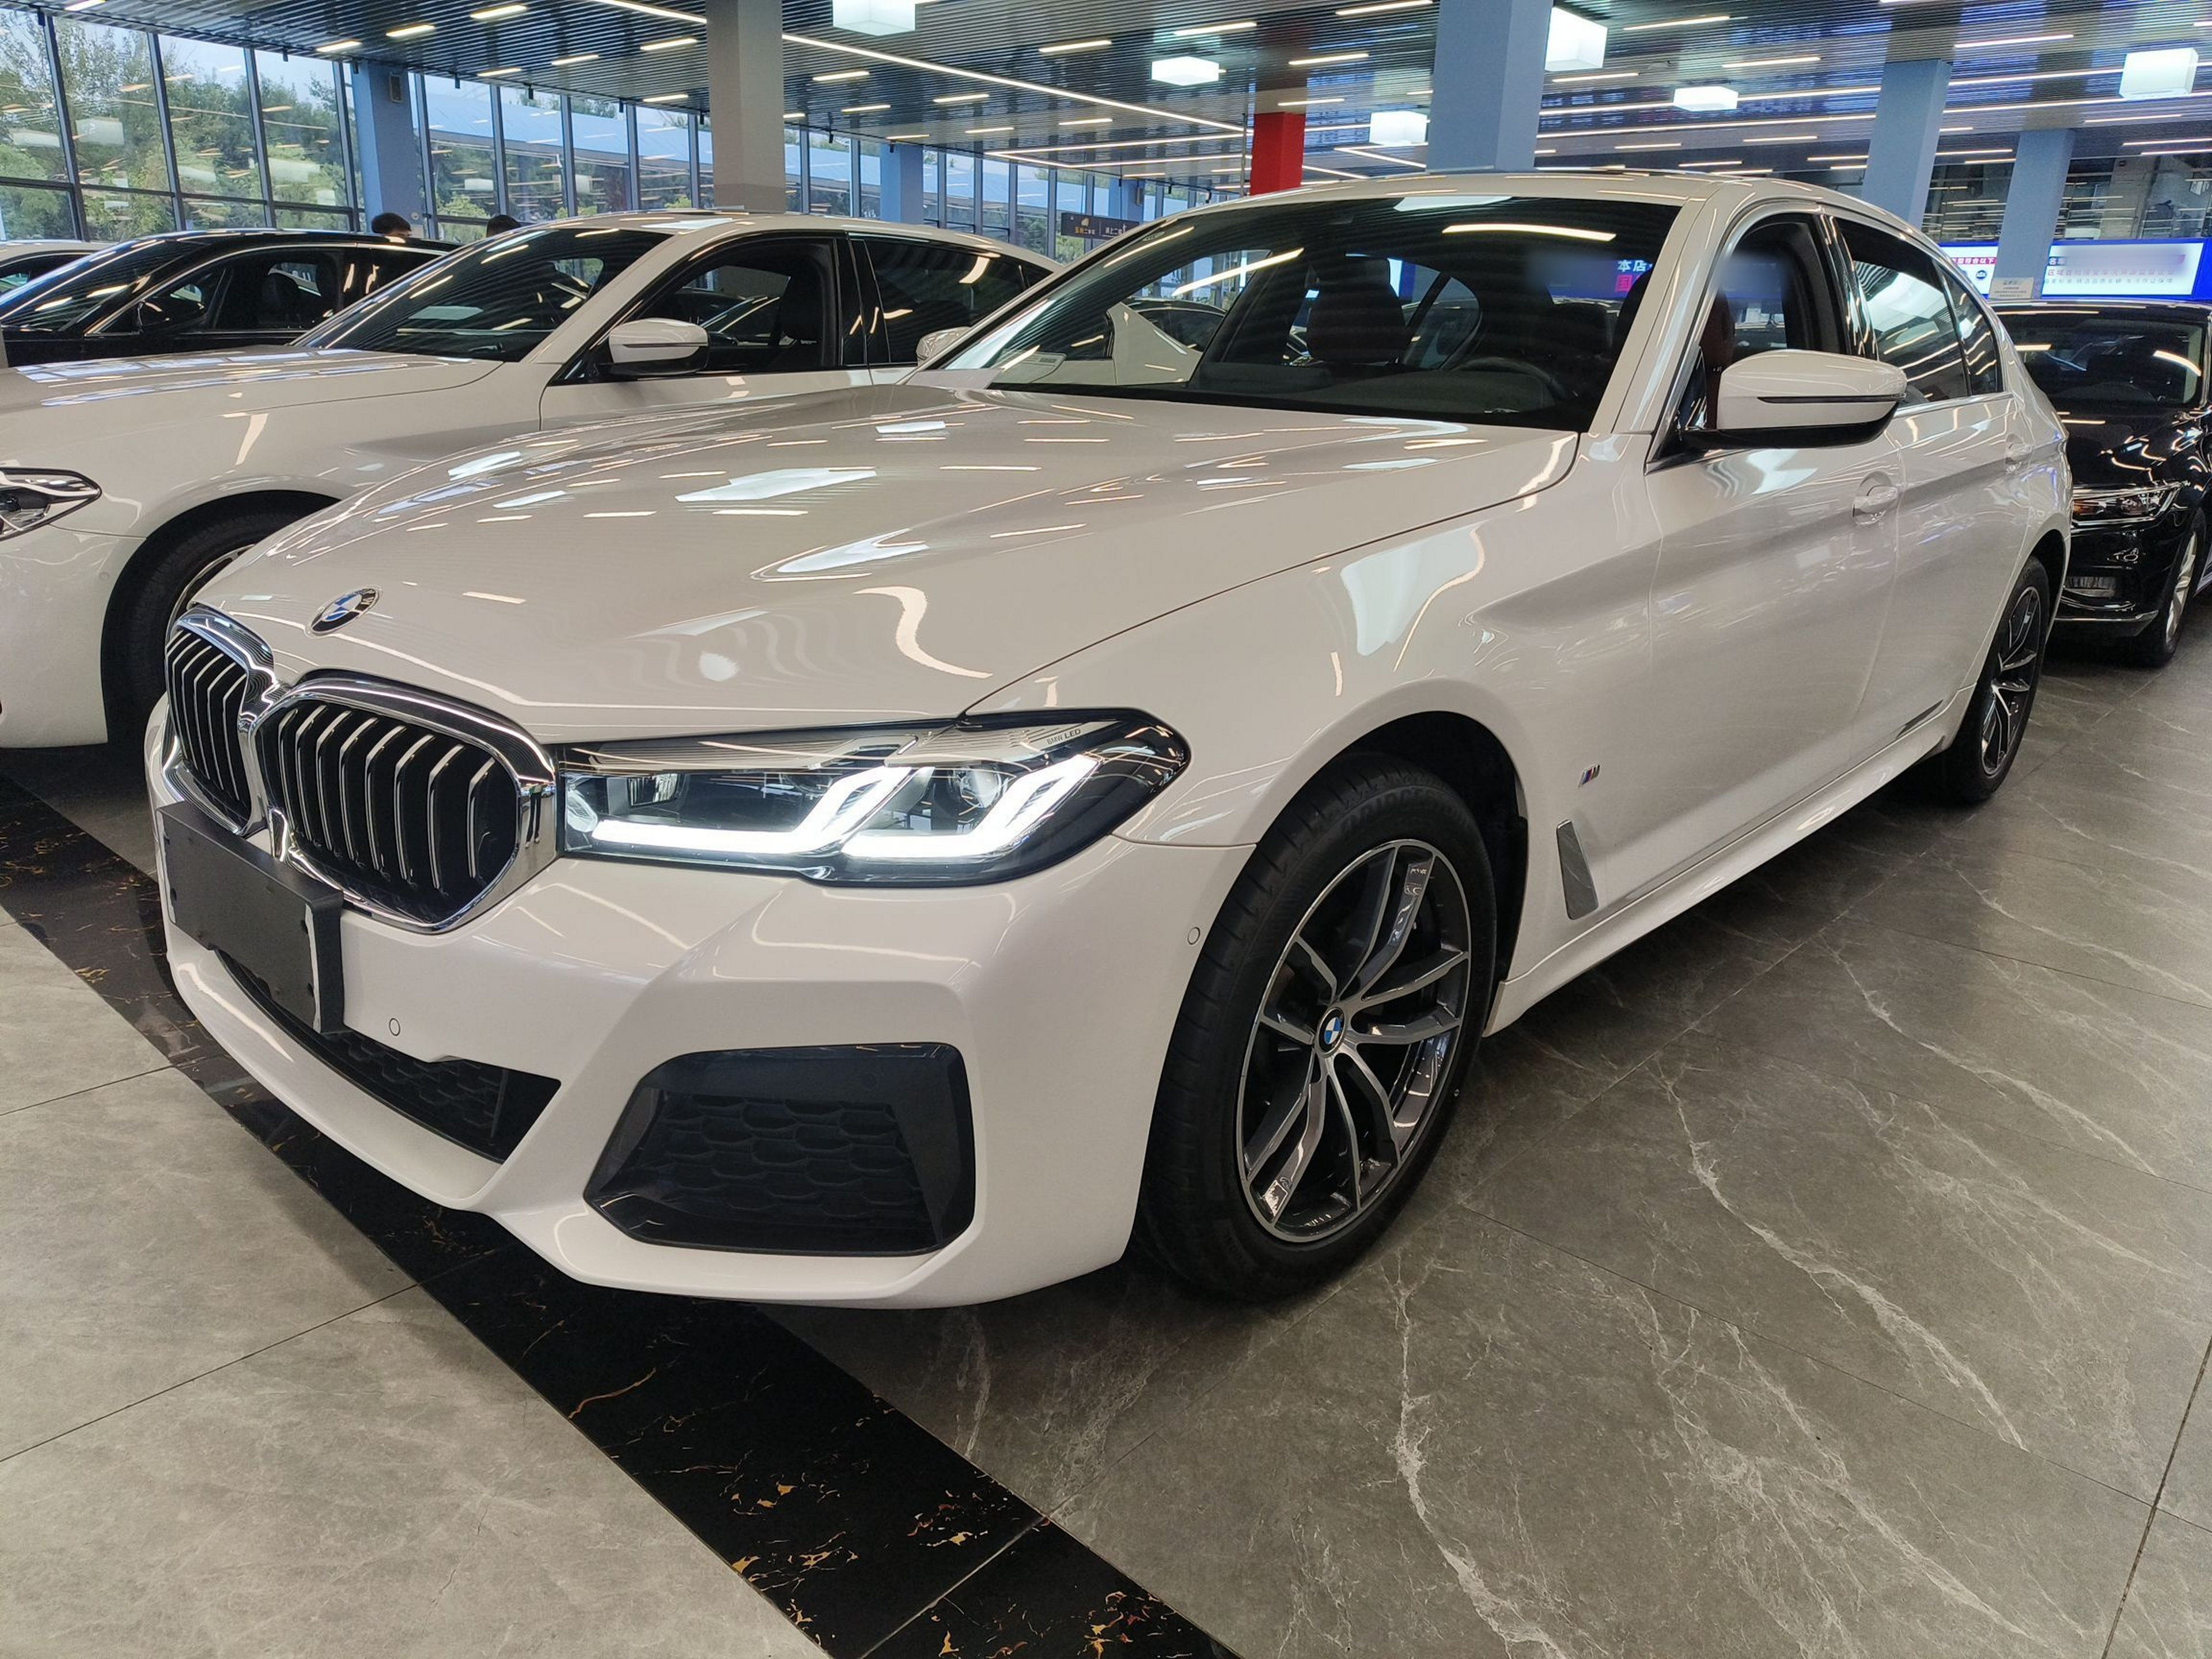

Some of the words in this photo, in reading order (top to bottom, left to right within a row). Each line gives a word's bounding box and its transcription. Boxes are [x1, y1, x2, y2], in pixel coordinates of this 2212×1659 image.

[1616, 260, 1652, 272] 本店
[1615, 275, 1639, 292] 国
[1046, 734, 1063, 745] BMW
[1065, 729, 1081, 738] LED
